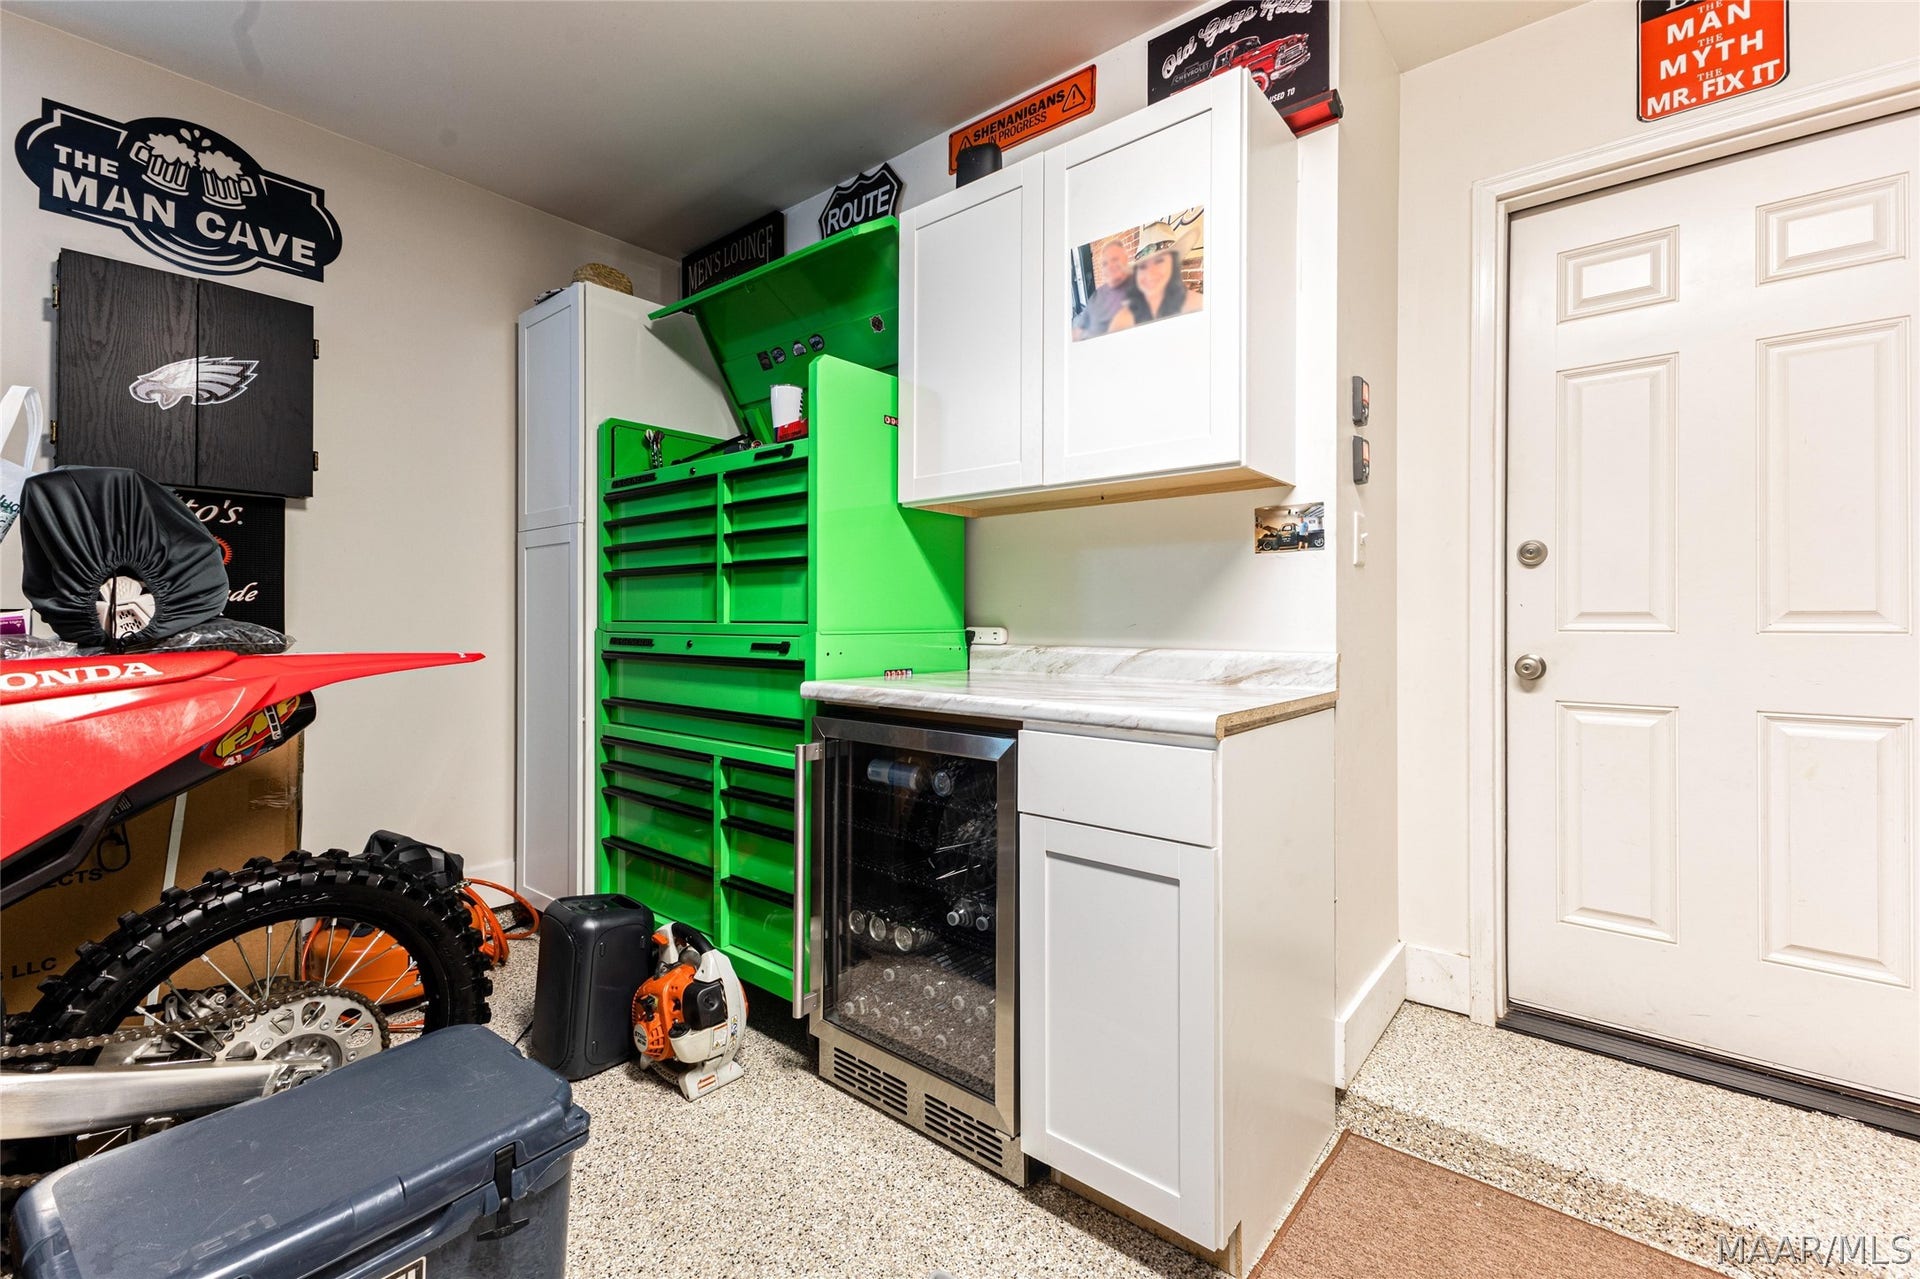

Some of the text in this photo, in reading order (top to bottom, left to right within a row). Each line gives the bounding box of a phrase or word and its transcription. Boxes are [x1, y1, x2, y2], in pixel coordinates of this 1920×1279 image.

[1667, 0, 1751, 45] MAN
[1697, 0, 1724, 13] THE
[1162, 35, 1198, 79] Old
[1198, 6, 1258, 48] Guys
[1660, 29, 1764, 80] MYTH
[1697, 33, 1724, 47] THE
[1174, 62, 1210, 83] CHEVROLET
[1647, 58, 1781, 117] MR. FIX IT
[1697, 68, 1723, 82] THE
[1287, 87, 1296, 97] TO
[973, 89, 1065, 143] SHENANIGANS
[987, 111, 1048, 144] IN PROGRESS
[53, 144, 119, 180] THE
[52, 168, 316, 267] MAN CAVE
[827, 184, 891, 235] ROUTE
[688, 251, 721, 297] MEN'S
[0, 662, 164, 691] ONDA
[43, 868, 103, 890] CTS
[11, 957, 57, 979] LLC
